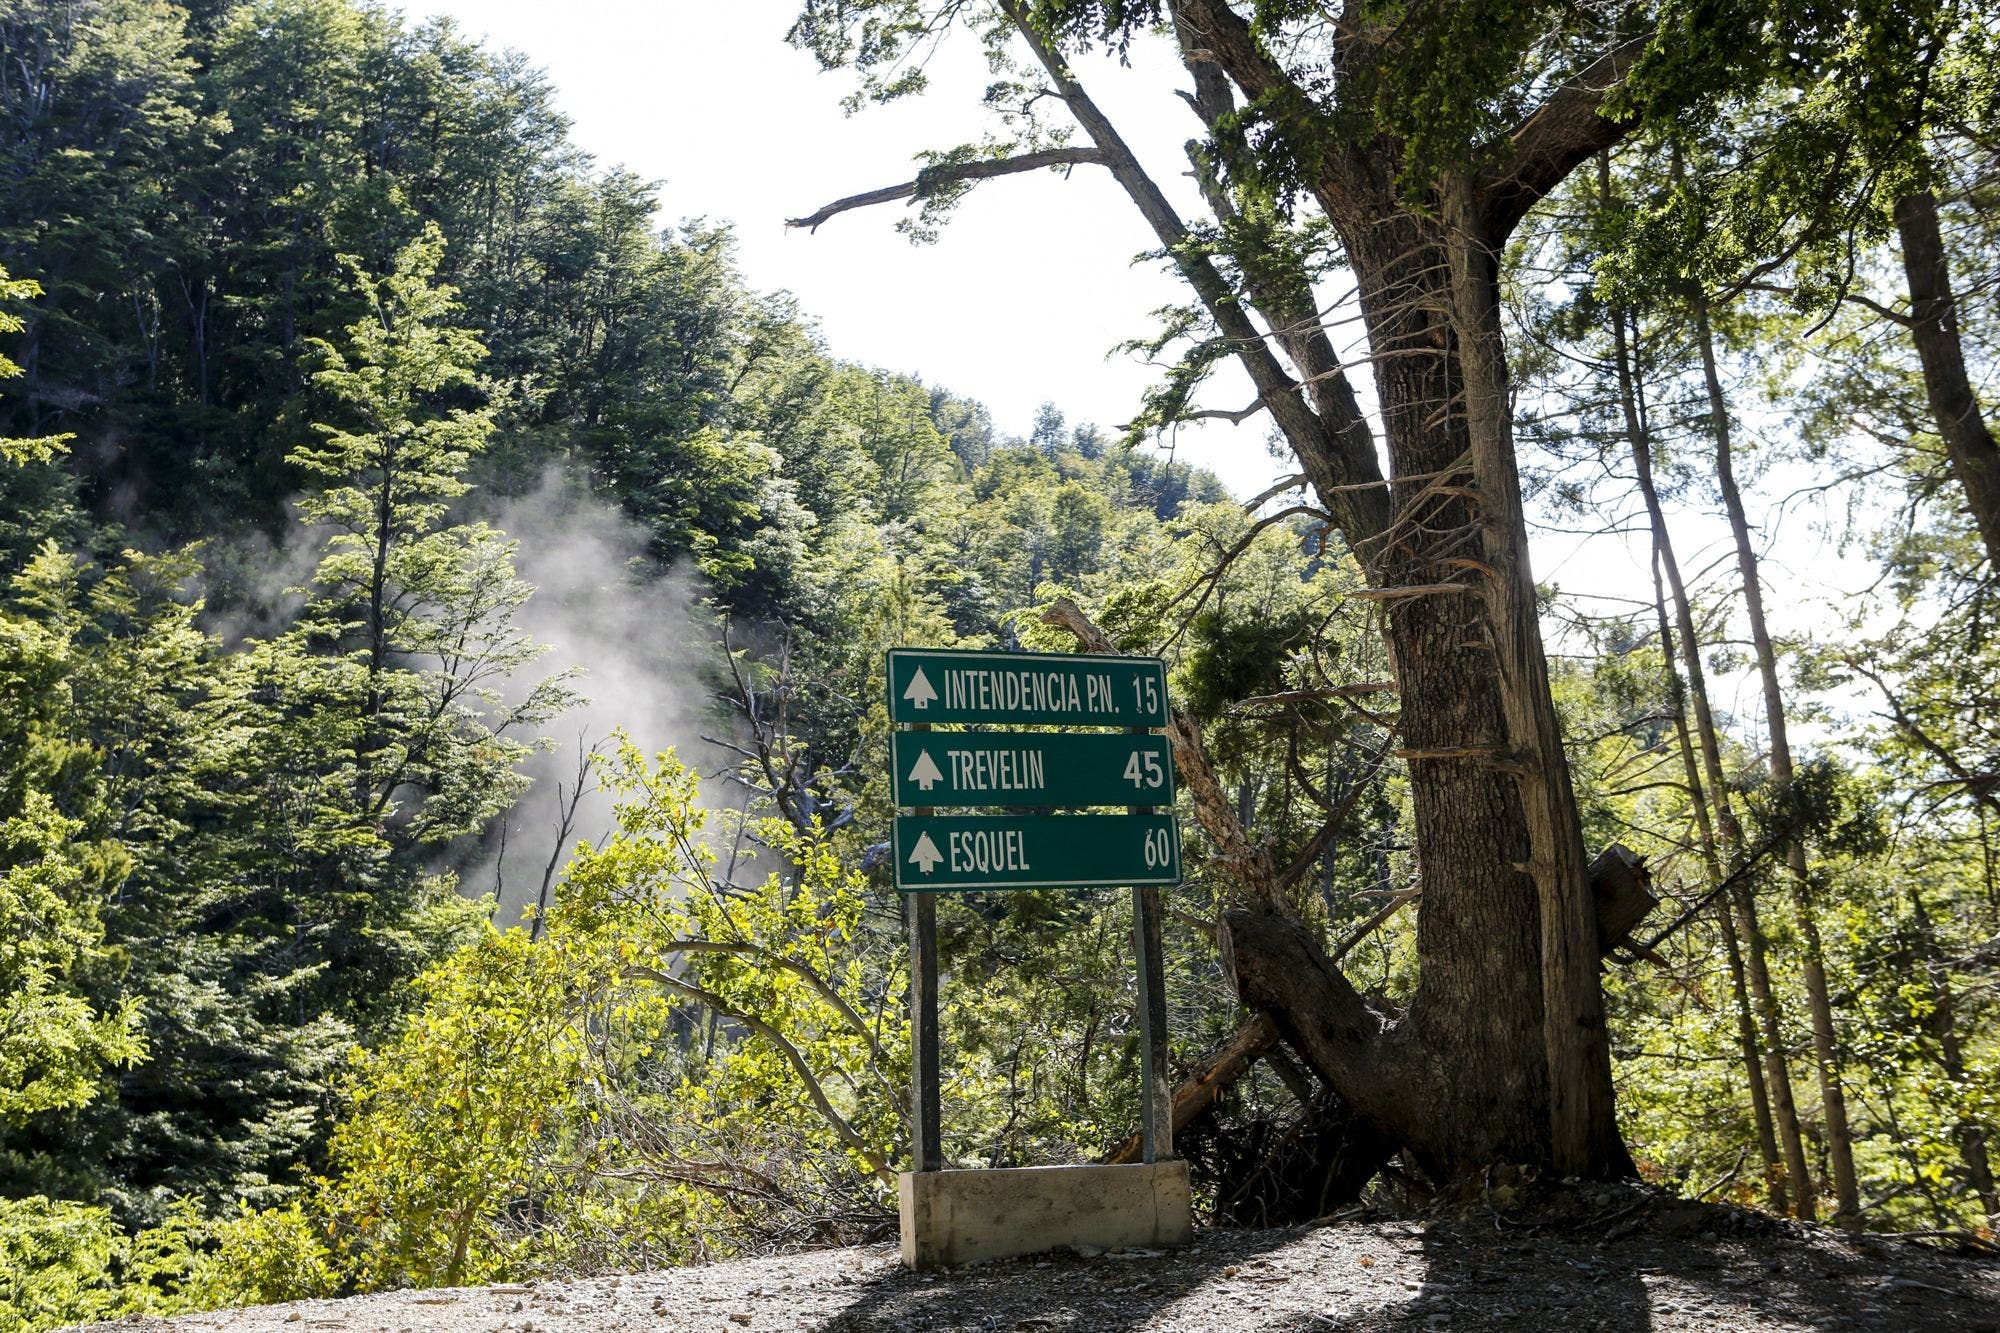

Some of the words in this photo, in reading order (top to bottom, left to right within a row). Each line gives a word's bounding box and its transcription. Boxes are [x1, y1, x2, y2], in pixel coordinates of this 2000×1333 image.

[944, 669, 1081, 712] INTENDENCIA
[1087, 674, 1120, 713] P.N.
[1132, 674, 1158, 715] 15
[948, 750, 1044, 790] TREVELIN
[1123, 750, 1164, 789] 45
[949, 831, 1030, 873] ESQUEL
[1144, 829, 1170, 868] 60
